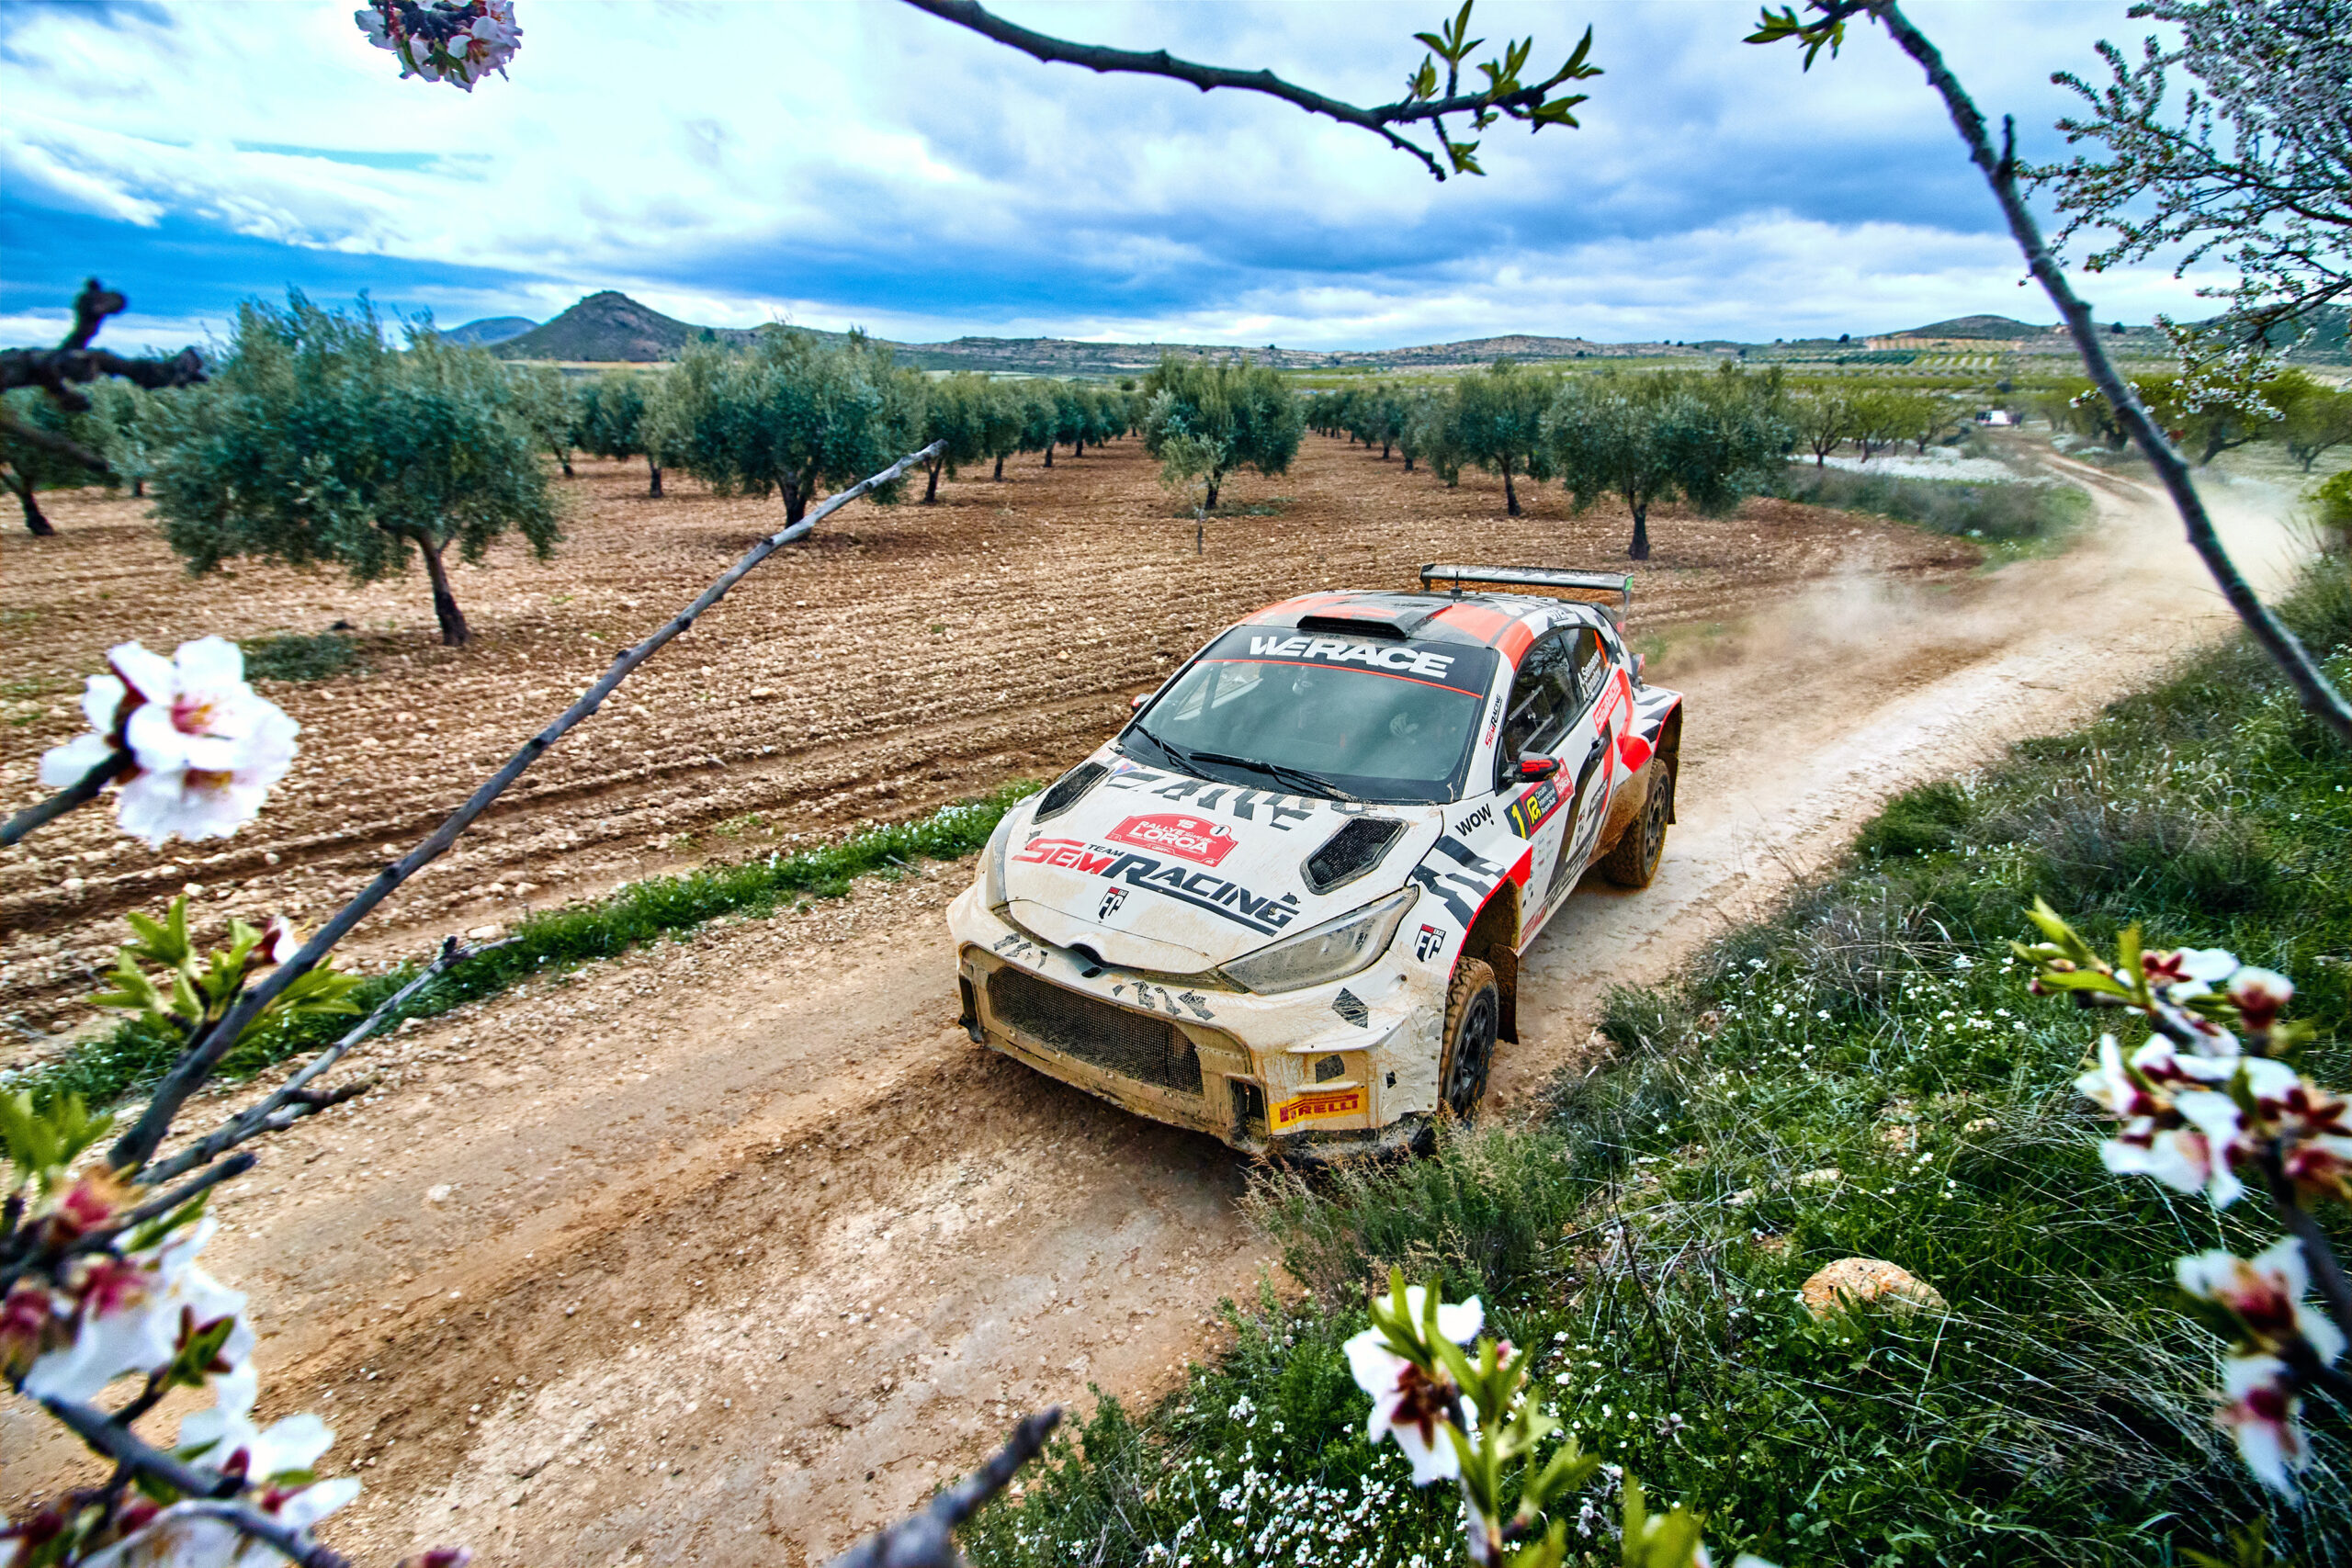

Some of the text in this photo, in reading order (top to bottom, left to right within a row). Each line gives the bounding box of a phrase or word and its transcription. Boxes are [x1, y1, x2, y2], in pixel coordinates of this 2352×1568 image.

[1250, 636, 1455, 679] WERACE
[1138, 821, 1185, 836] RALLYE
[1177, 819, 1197, 829] 15
[1511, 804, 1527, 840] 1
[1214, 826, 1226, 835] 1
[1089, 843, 1125, 857] TEAM
[1280, 1094, 1359, 1122] PIRELLI
